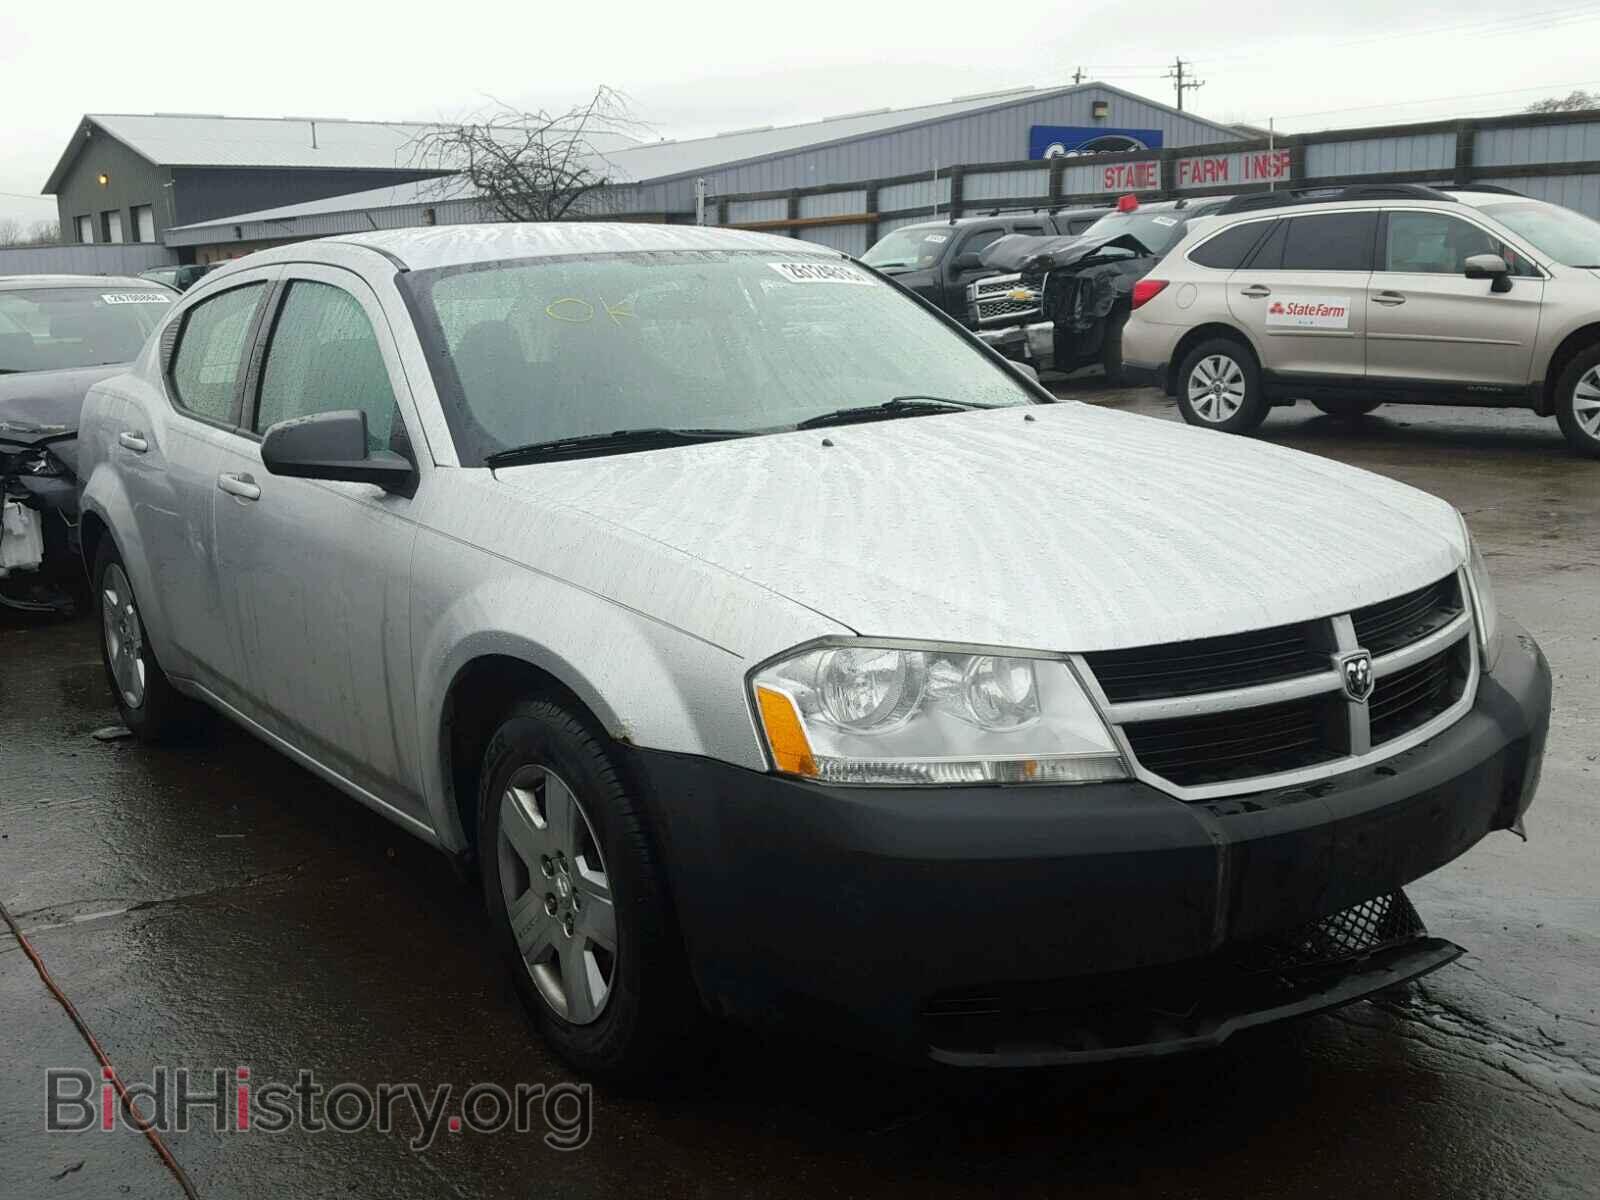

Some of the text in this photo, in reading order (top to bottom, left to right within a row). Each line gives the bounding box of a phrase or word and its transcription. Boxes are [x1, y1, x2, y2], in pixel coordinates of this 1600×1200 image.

[1104, 151, 1295, 189] STATE FARM INSP
[544, 296, 637, 327] OK
